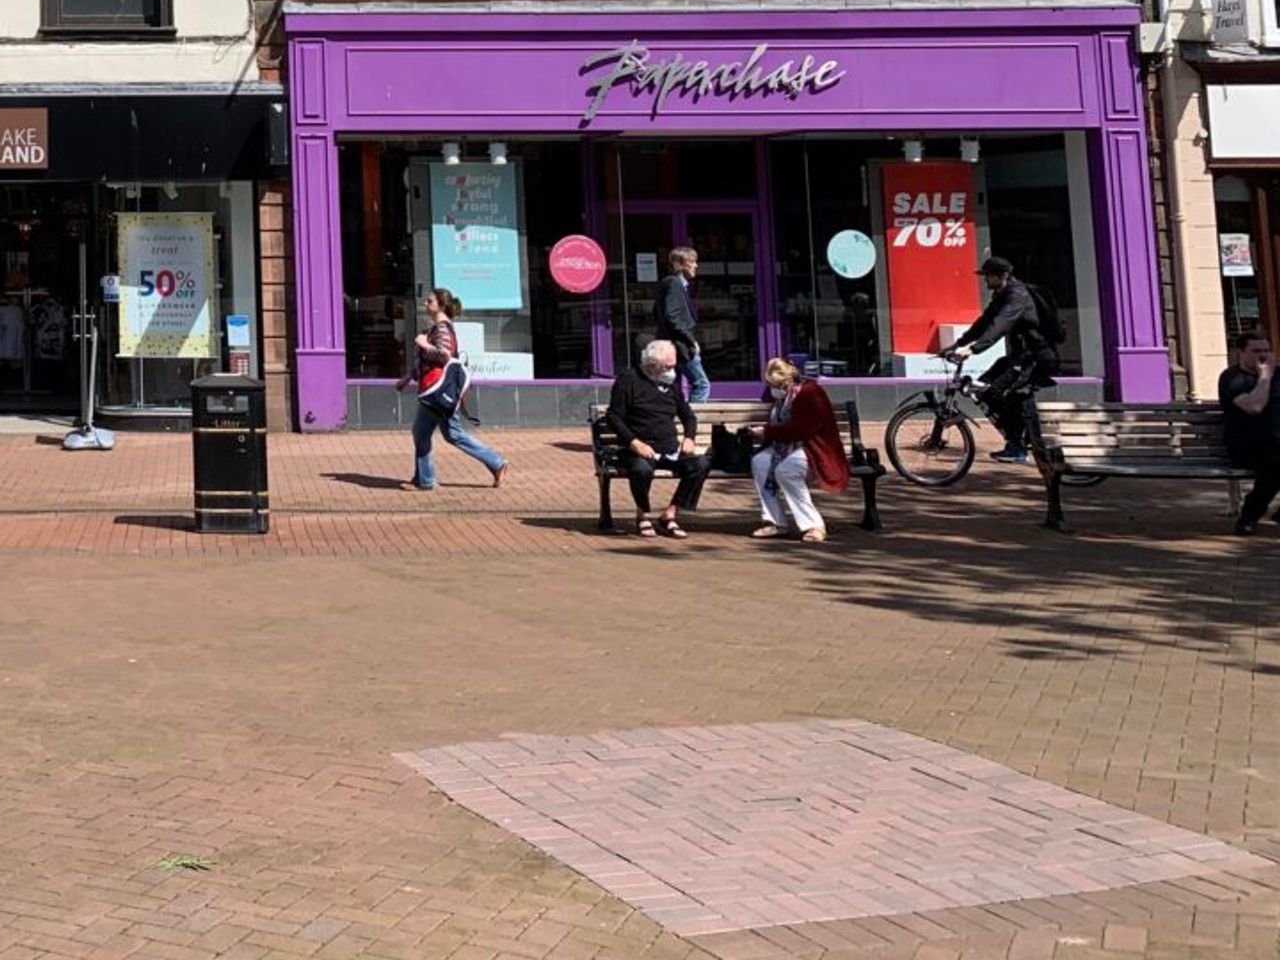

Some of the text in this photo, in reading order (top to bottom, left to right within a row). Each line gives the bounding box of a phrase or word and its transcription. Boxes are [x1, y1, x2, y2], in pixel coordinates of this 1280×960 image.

[1217, 0, 1241, 14] Hays
[1215, 13, 1244, 29] Travel
[583, 38, 846, 122] Paperchase
[892, 192, 967, 215] SALE
[892, 217, 966, 247] 70%
[943, 236, 967, 248] OFF
[139, 269, 195, 298] 50%
[175, 290, 196, 298] OFF
[214, 419, 241, 428] Litter
